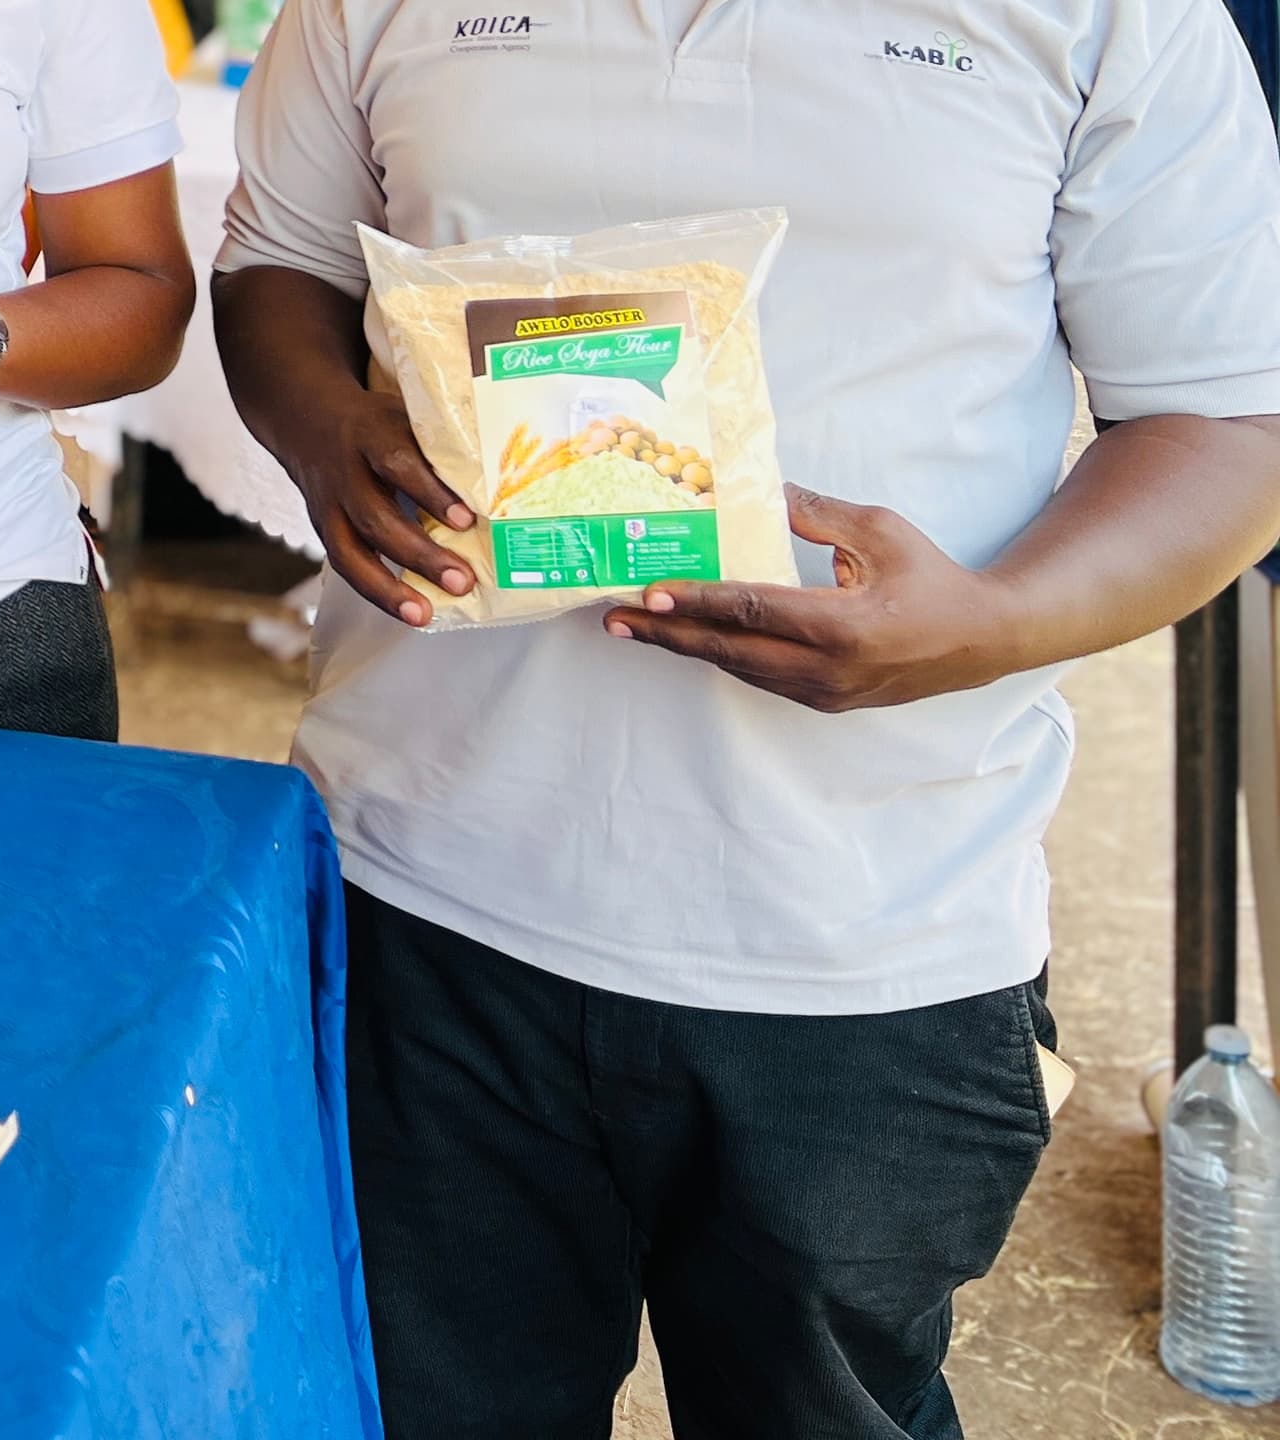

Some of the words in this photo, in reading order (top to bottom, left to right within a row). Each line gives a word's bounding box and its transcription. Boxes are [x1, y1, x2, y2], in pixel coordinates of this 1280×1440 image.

[453, 15, 531, 39] KOICA
[517, 317, 570, 335] AWELO
[573, 310, 644, 329] BOOSTER
[502, 345, 554, 371] Rice
[558, 339, 611, 370] Soya
[614, 332, 672, 358] Flour
